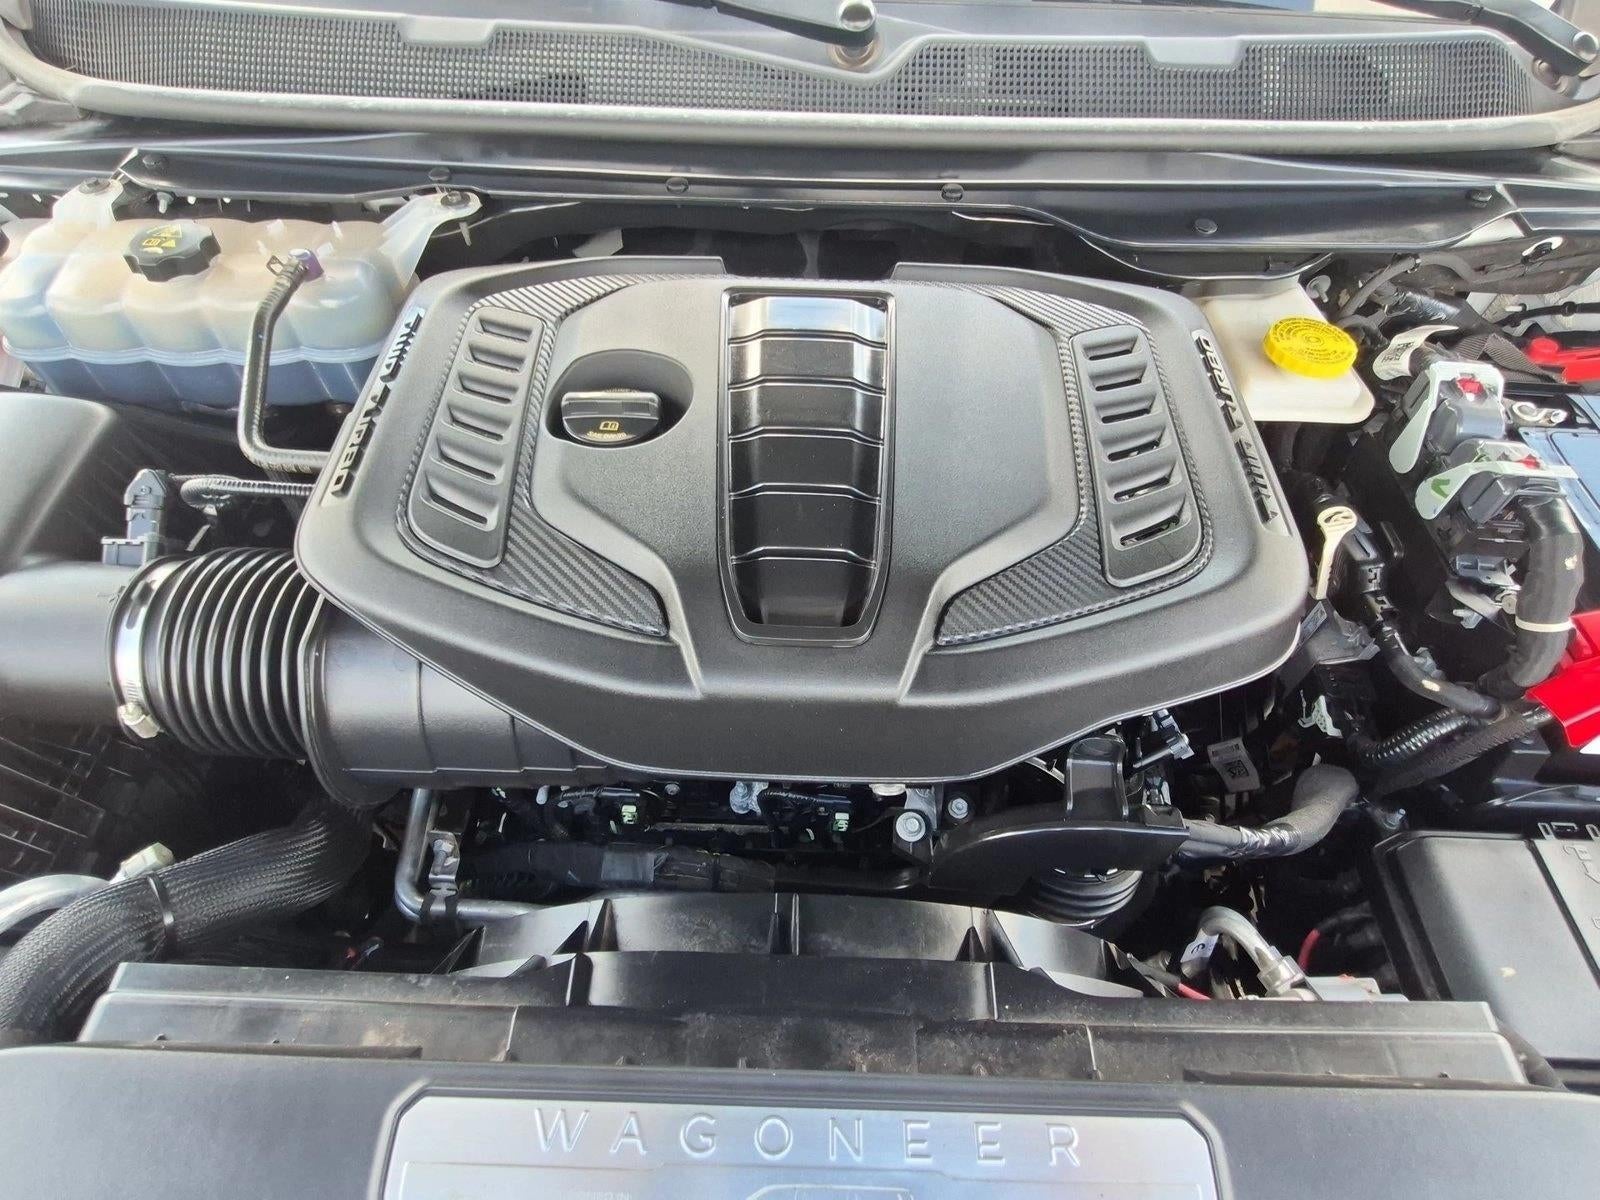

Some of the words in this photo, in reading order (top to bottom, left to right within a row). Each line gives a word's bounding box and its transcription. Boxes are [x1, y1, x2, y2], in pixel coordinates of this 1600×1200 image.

[1194, 335, 1245, 434] TURBO
[331, 384, 392, 498] TURBO
[534, 1107, 1082, 1168] WAGONEER
